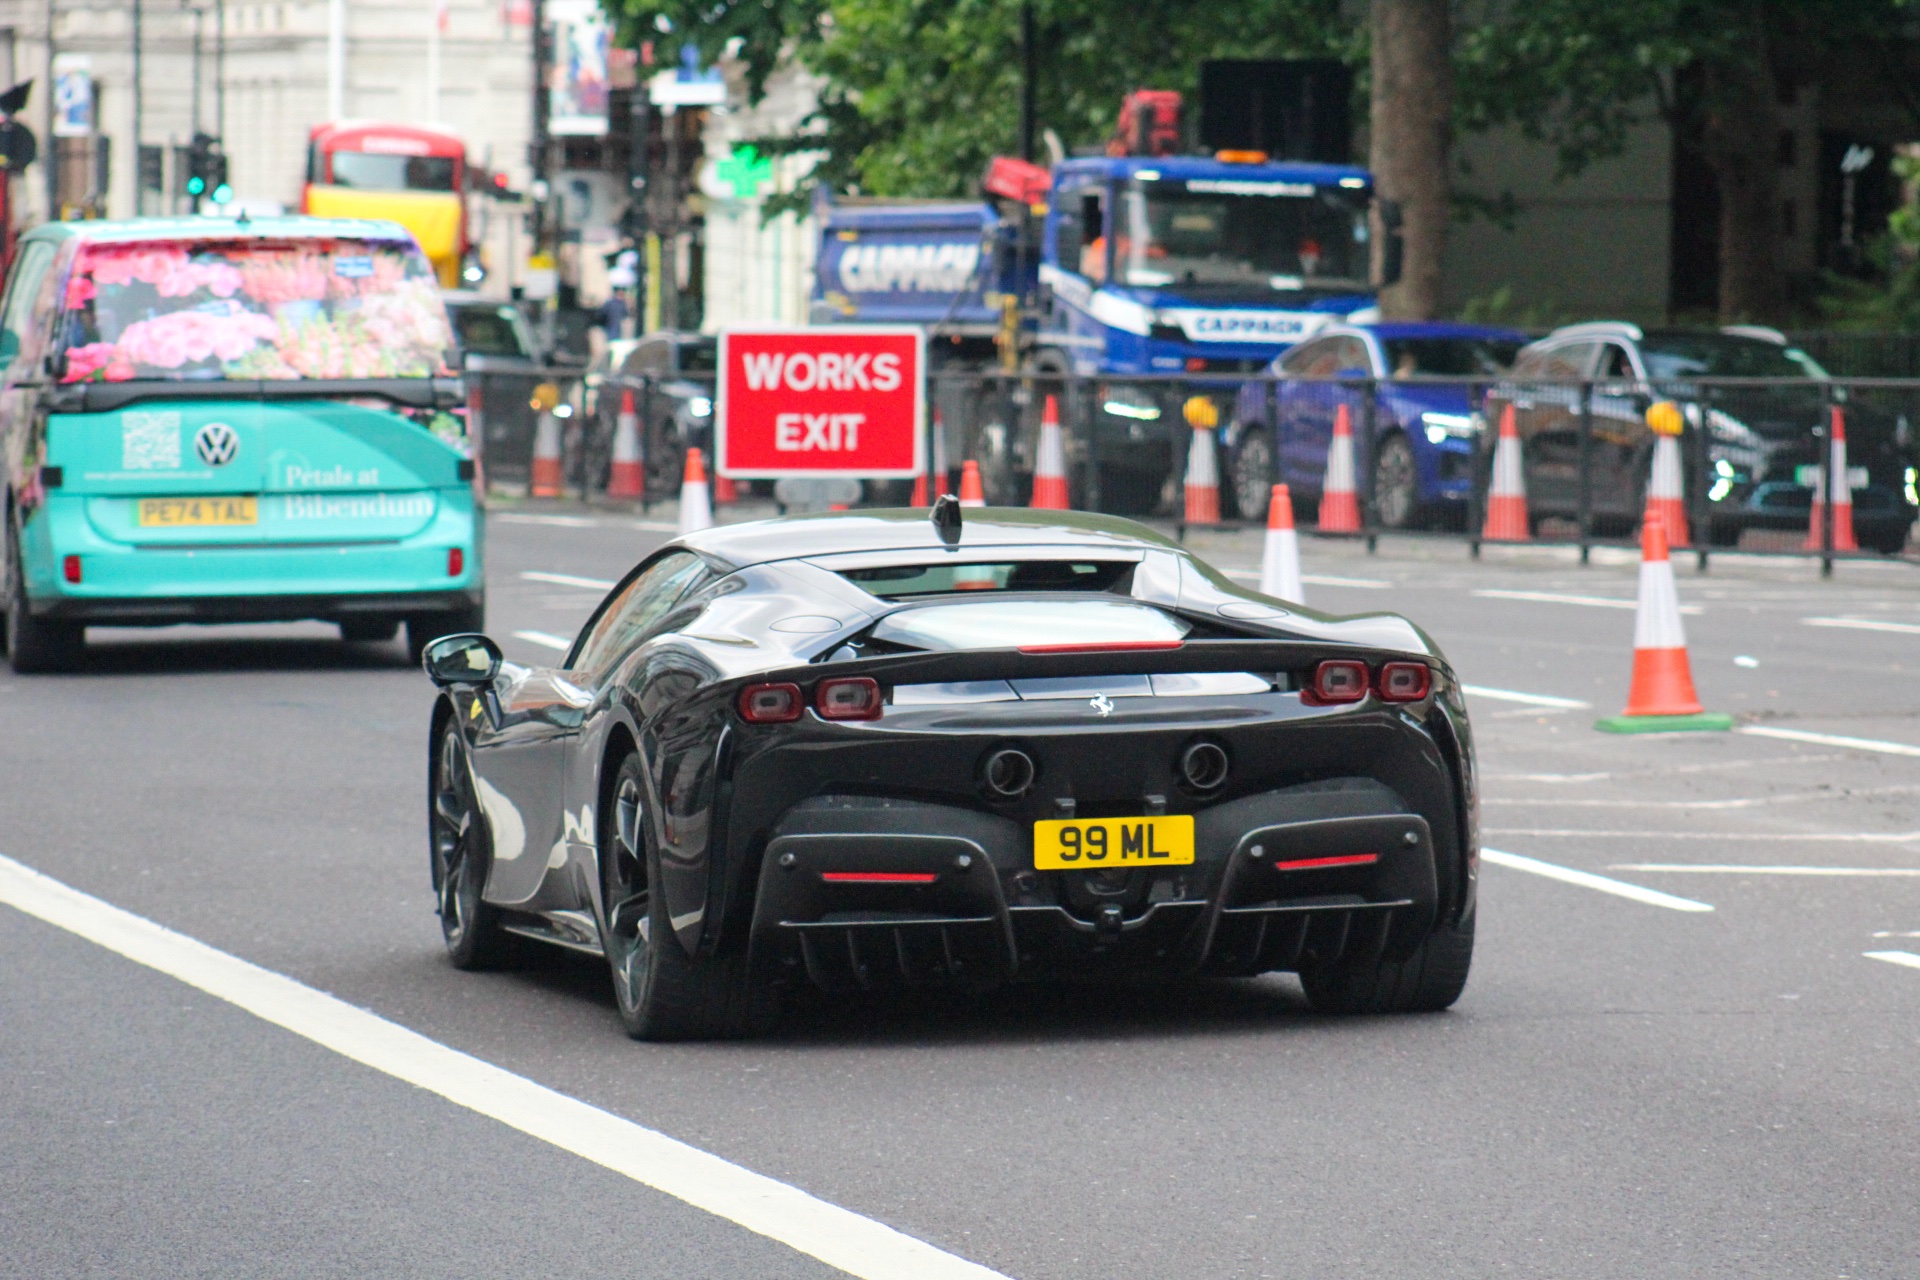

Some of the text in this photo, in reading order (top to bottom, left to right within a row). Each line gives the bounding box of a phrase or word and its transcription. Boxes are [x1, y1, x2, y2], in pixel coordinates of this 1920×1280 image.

[742, 352, 902, 392] WORKS
[775, 412, 867, 452] EXIT
[287, 464, 380, 487] Petals at
[143, 499, 254, 522] PE74 TAL
[286, 492, 434, 520] Bibendum
[1059, 823, 1170, 862] 99 ML
